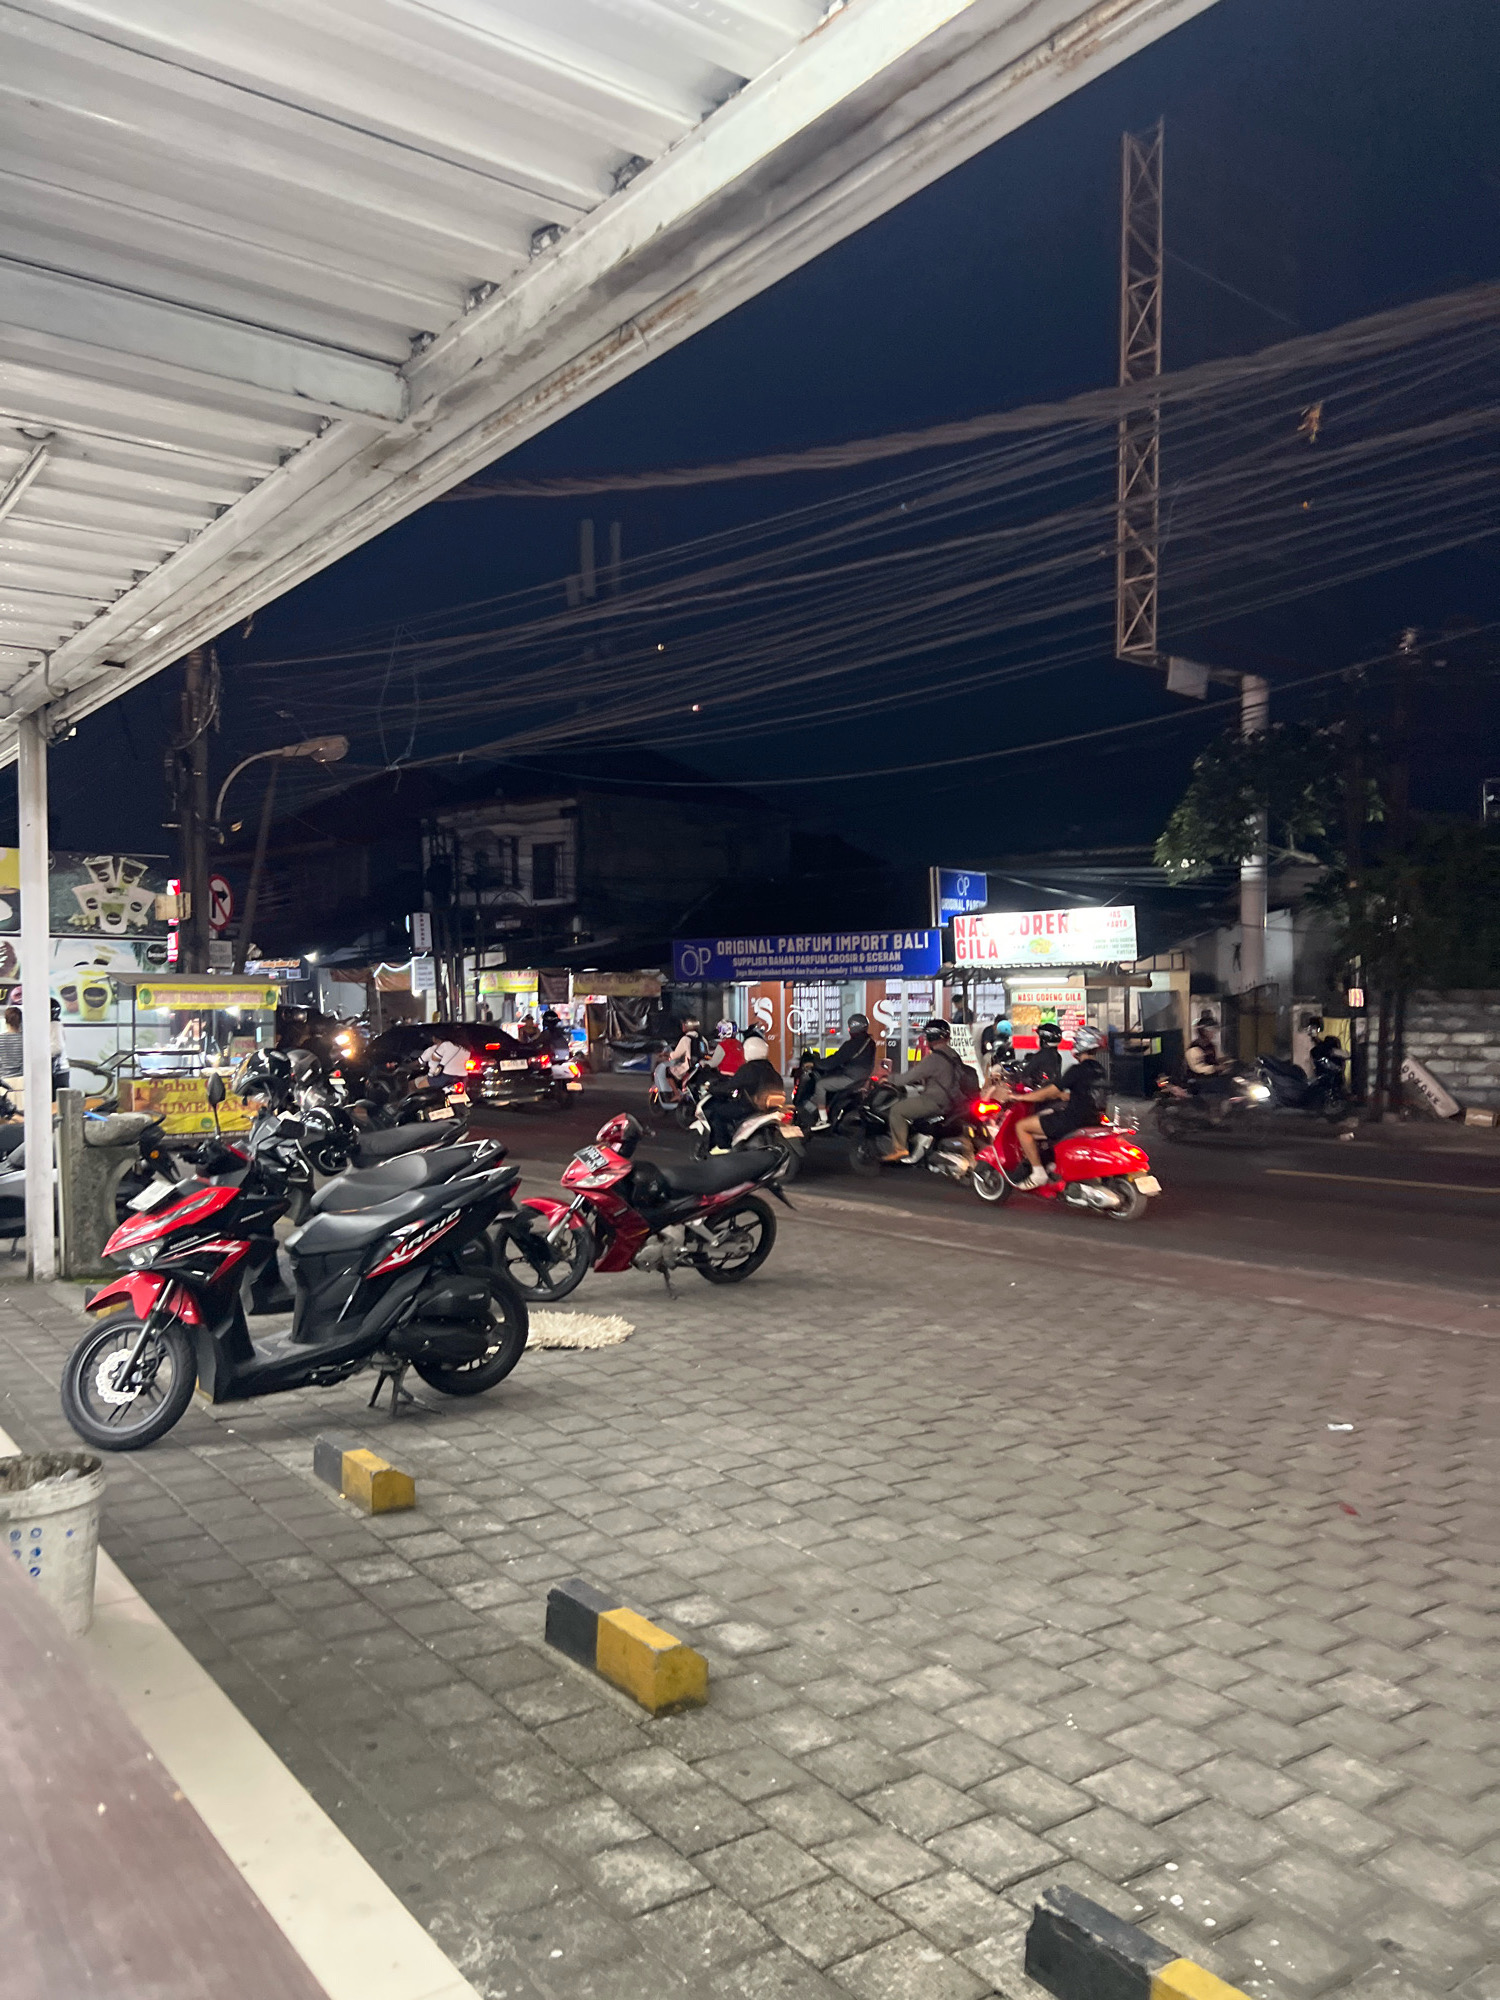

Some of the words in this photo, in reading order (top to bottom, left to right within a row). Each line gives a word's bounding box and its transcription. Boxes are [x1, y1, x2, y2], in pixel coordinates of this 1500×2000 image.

[955, 917, 989, 938] NA
[717, 939, 775, 956] ORIGINAL
[778, 936, 832, 953] PARFUM
[836, 934, 889, 951] IMPORT
[893, 931, 929, 950] BALI
[957, 939, 999, 960] GILA
[733, 956, 768, 967] SUPPLIER
[769, 955, 794, 966] BAHAN
[795, 953, 827, 965] PARFUM
[828, 952, 858, 964] GROSIR
[866, 951, 901, 963] ECERAN
[1018, 993, 1034, 1002] NASI
[1036, 992, 1063, 1002] GORENG
[1065, 992, 1082, 1001] GILA
[149, 1079, 198, 1092] Tahu
[391, 1208, 461, 1260] VARIO
